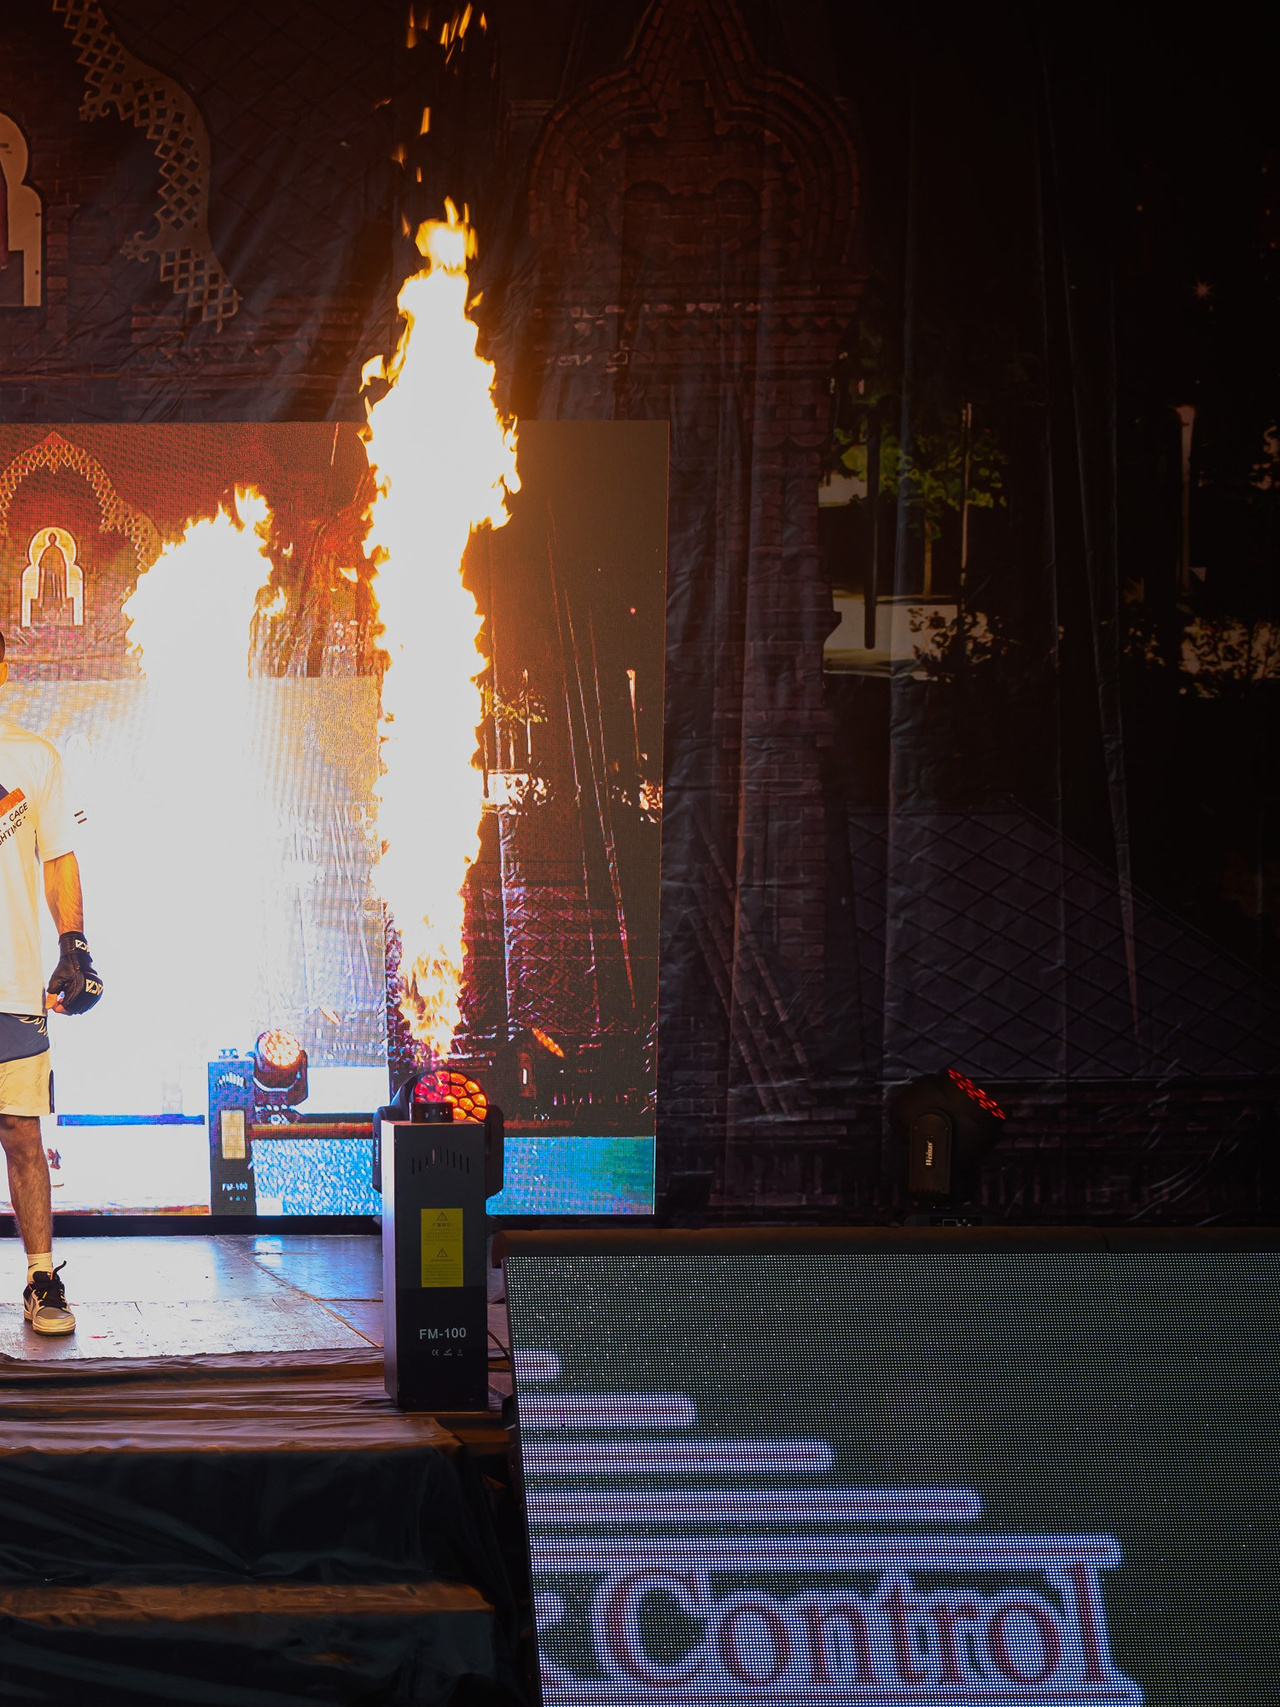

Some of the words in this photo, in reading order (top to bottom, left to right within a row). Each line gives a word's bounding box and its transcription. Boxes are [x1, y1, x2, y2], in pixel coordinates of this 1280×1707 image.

[8, 802, 28, 822] CAGE
[419, 1327, 467, 1339] FM-100
[605, 1562, 1108, 1689] Control
